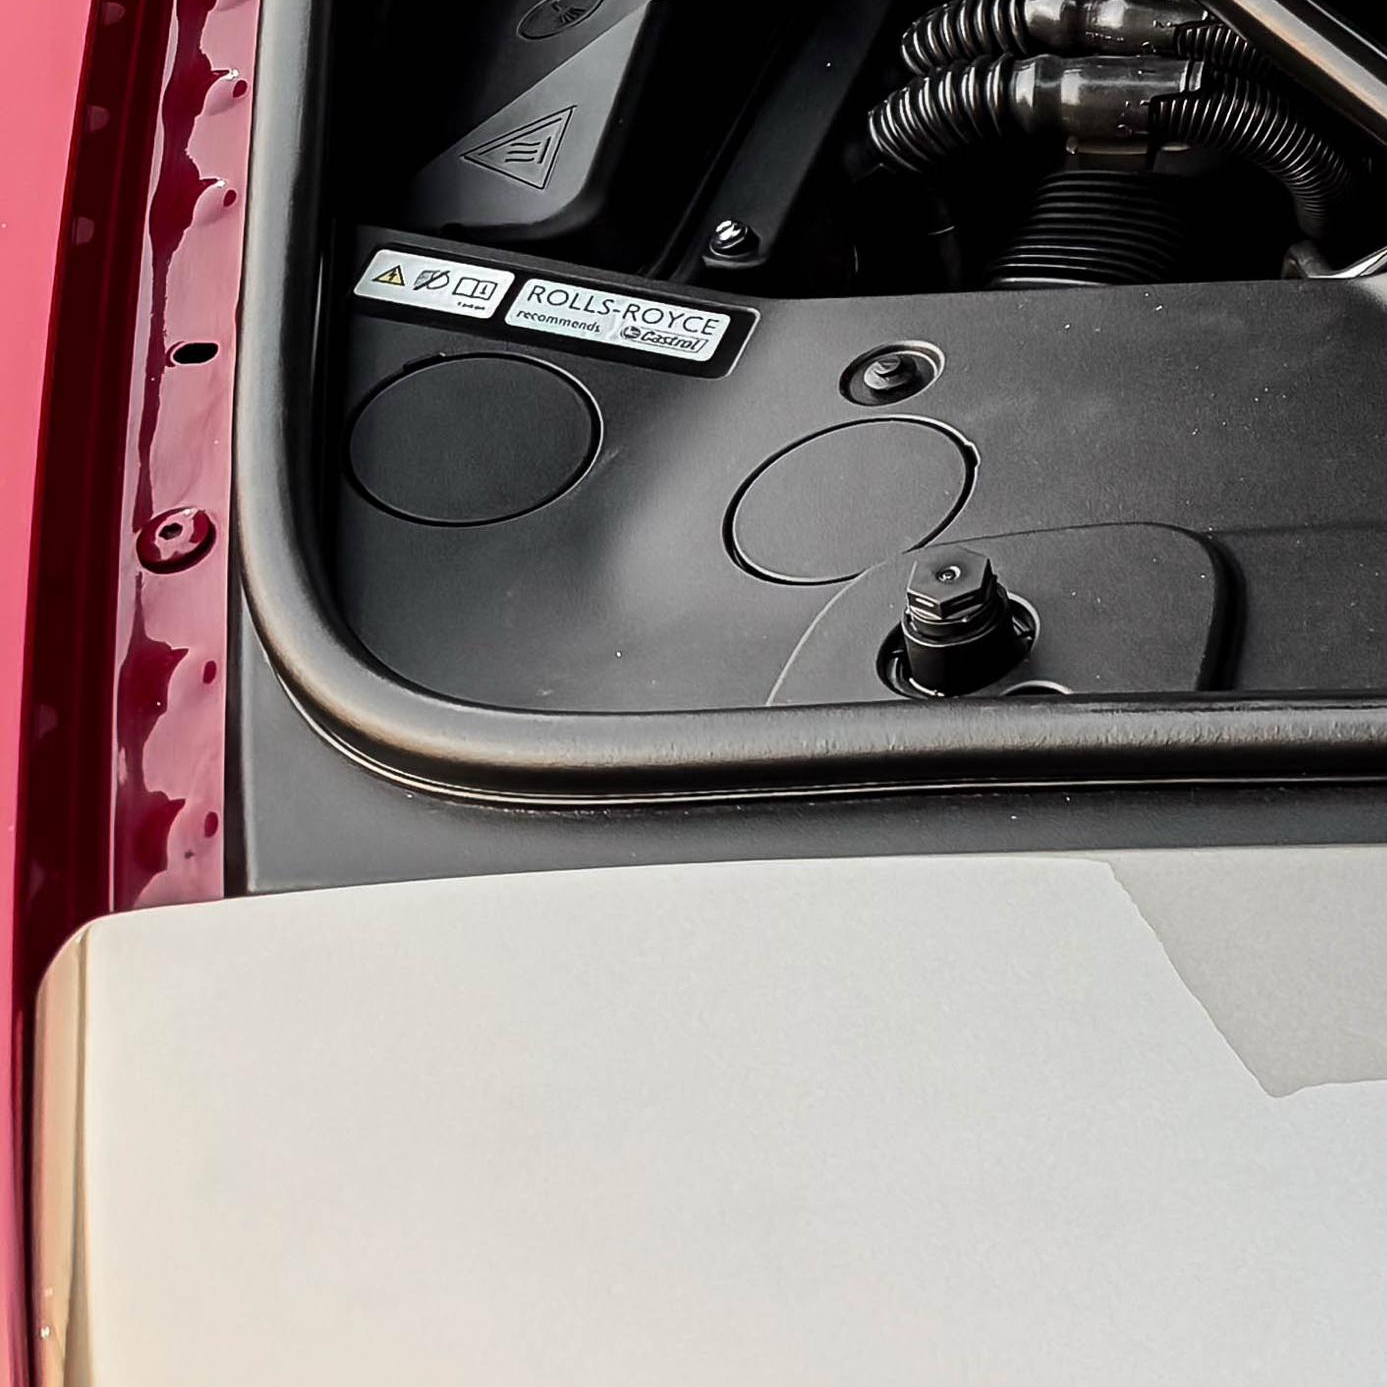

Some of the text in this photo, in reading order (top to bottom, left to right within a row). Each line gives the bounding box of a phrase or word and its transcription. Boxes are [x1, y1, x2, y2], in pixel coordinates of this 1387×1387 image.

[516, 310, 701, 351] recommends Castrol
[526, 284, 721, 337] ROLLS-ROYCE
